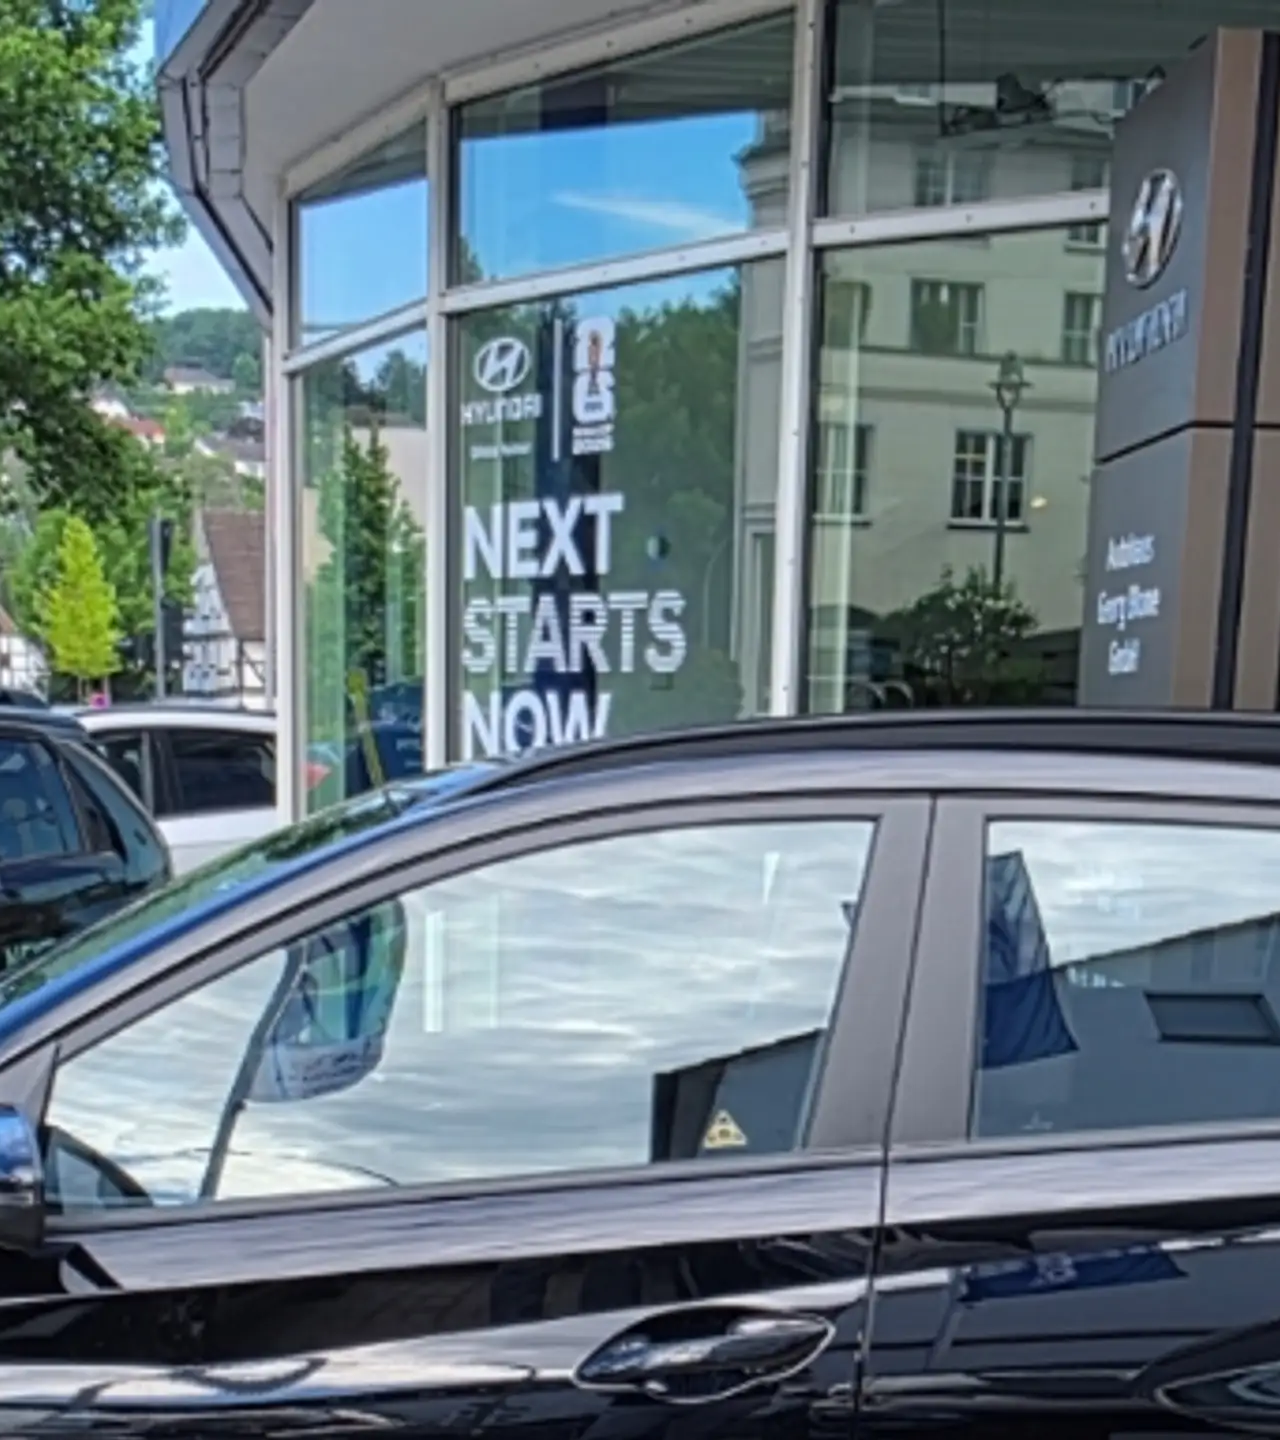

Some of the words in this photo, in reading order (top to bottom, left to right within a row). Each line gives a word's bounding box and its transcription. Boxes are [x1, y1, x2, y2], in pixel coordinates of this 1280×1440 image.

[460, 394, 542, 425] HYUNDAI
[464, 494, 624, 580] NEXT
[461, 589, 687, 674] STARTS
[463, 689, 611, 761] NOW
